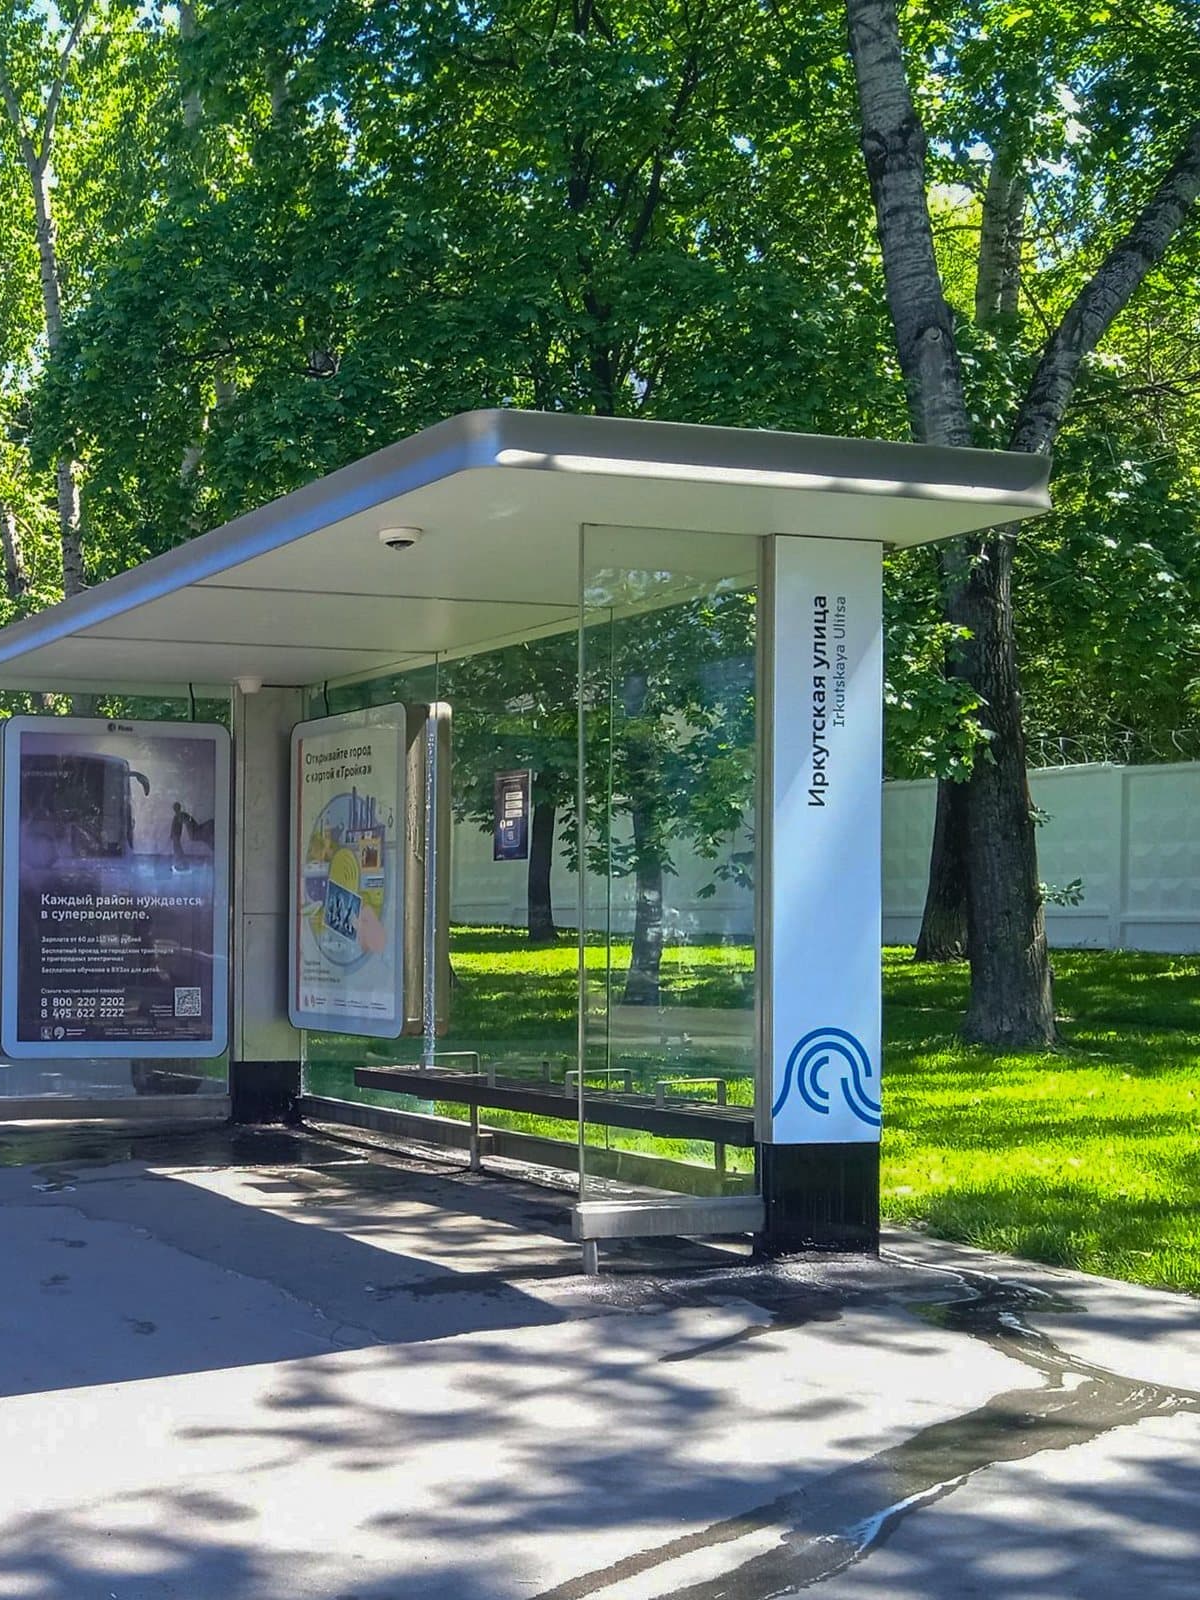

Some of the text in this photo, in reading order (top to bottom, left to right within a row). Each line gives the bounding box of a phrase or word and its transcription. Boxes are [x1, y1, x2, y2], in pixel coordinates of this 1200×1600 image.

[833, 596, 848, 727] Irkutskaya Ulitsa
[808, 595, 830, 806] Иркутская улица
[306, 745, 371, 765] Открывайте город
[305, 773, 310, 783] с
[311, 767, 334, 784] картой
[41, 893, 201, 908] Каждый район нуждается
[41, 909, 150, 922] в суперводителе.
[41, 997, 125, 1007] 8 800 220 2202
[41, 1008, 125, 1018] 8 495 622 2222
